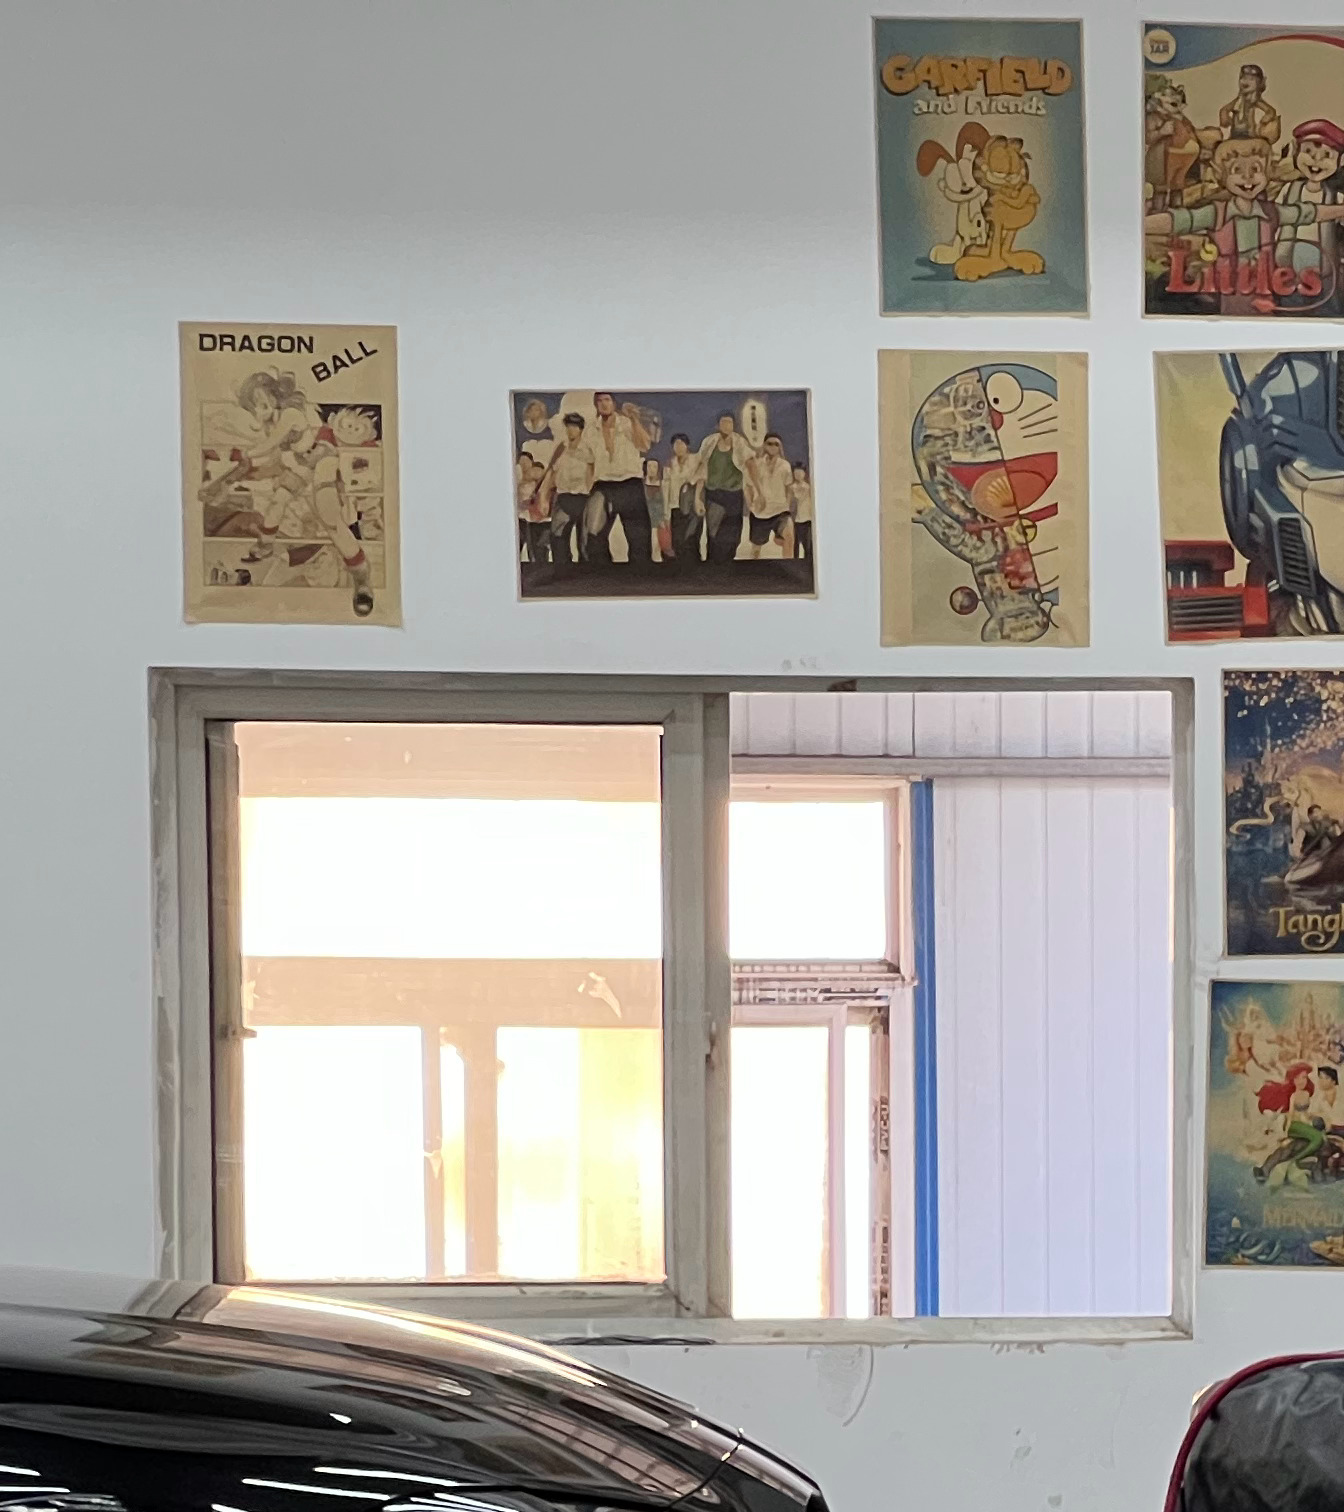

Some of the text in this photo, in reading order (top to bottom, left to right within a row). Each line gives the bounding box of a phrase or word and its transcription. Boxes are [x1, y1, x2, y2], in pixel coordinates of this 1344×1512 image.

[881, 54, 1073, 97] GARFIELD
[913, 95, 1047, 117] and Friends
[198, 333, 314, 354] DRAGON
[311, 340, 378, 383] BALL
